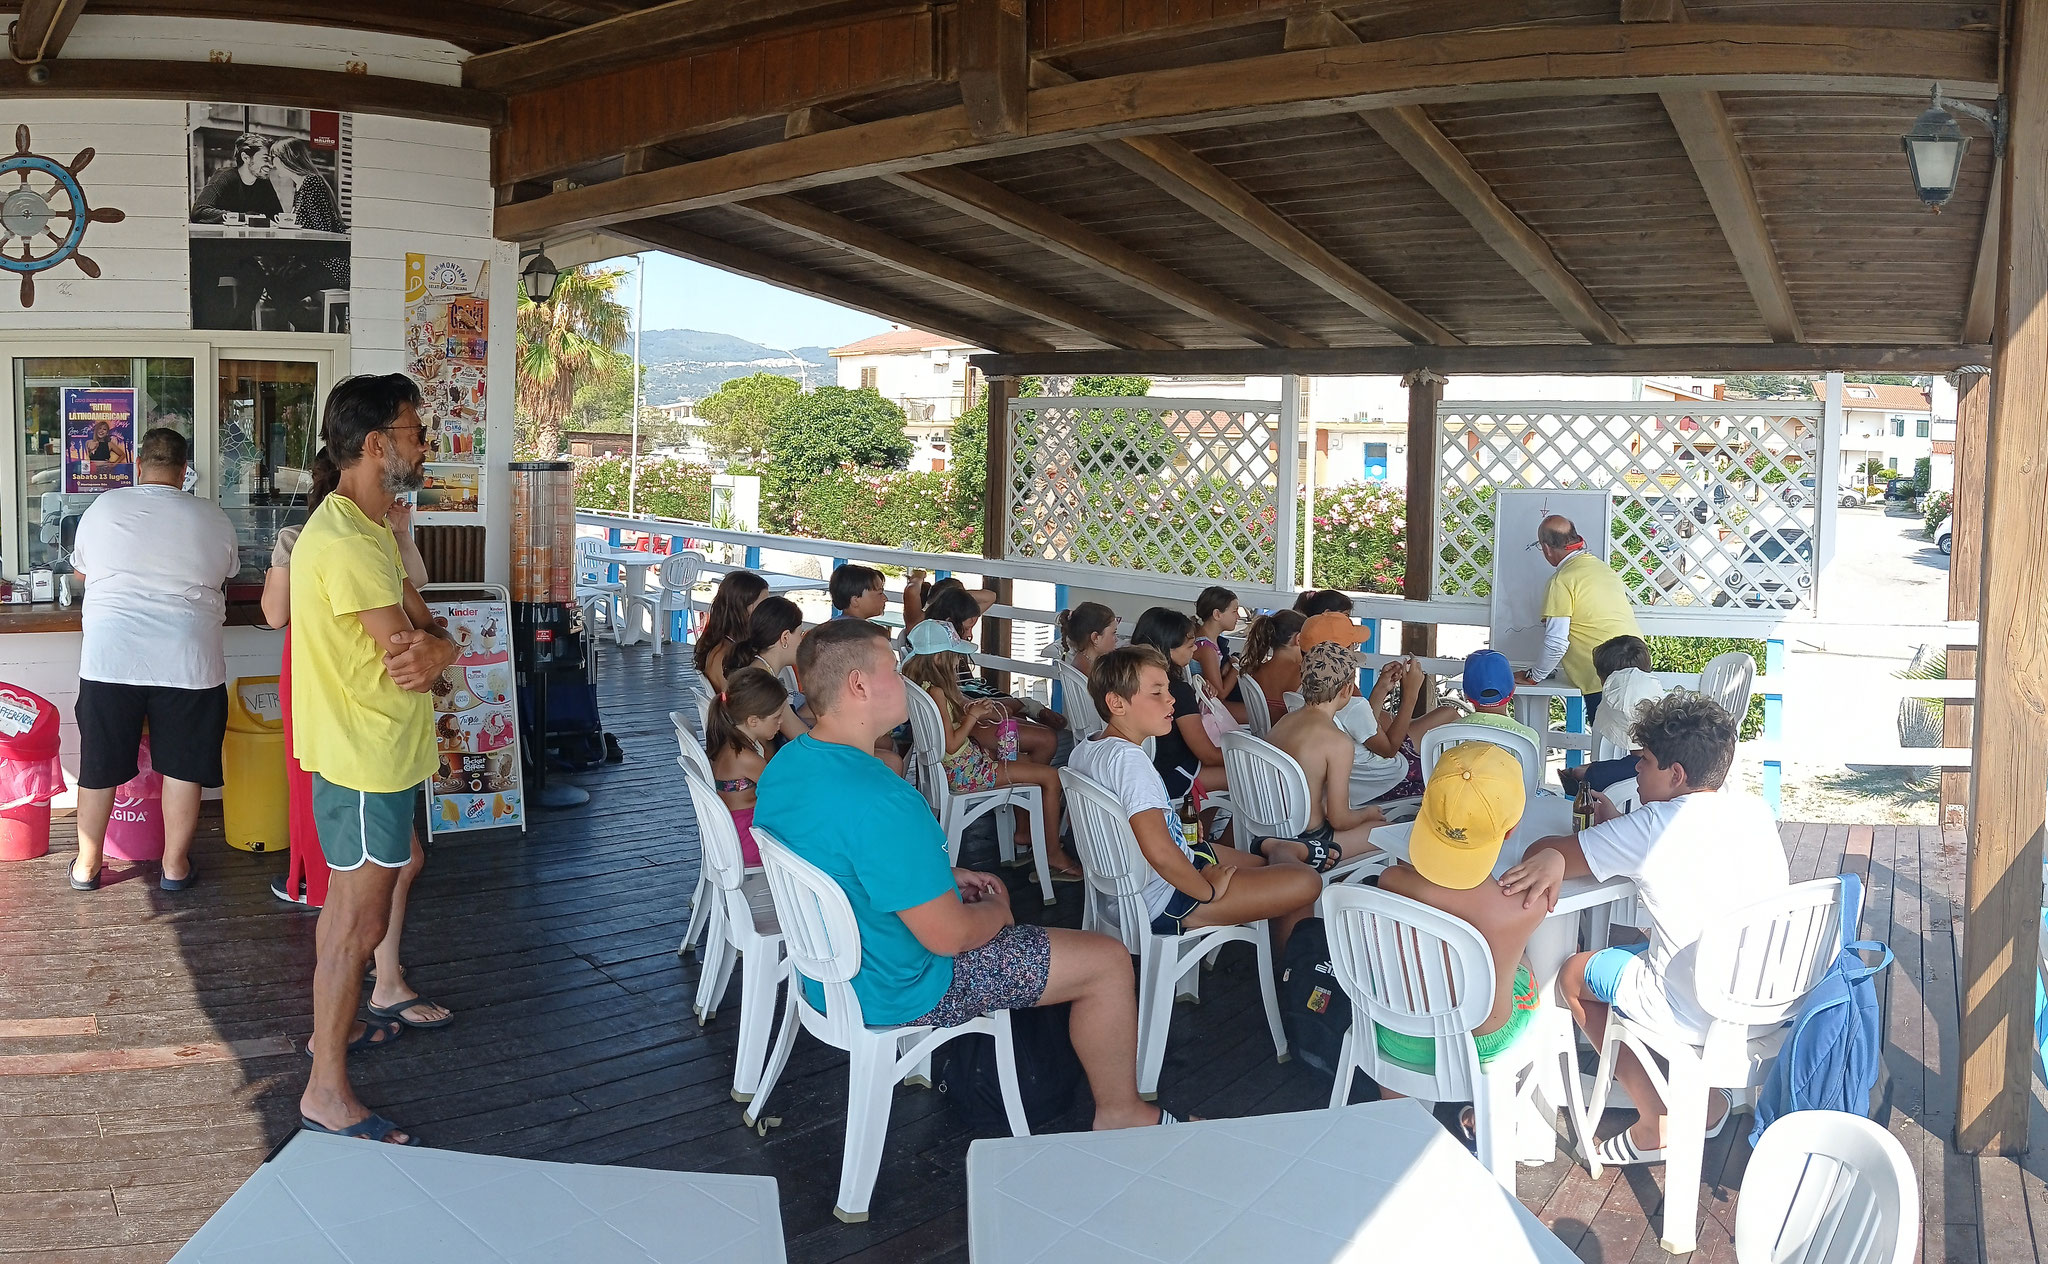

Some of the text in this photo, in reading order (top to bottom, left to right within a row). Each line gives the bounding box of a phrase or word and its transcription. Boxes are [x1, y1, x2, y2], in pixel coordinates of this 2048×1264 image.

[428, 261, 468, 283] SAMMONTANA
[109, 473, 129, 481] luglio
[245, 692, 280, 710] VETR
[110, 809, 147, 822] GIDA
